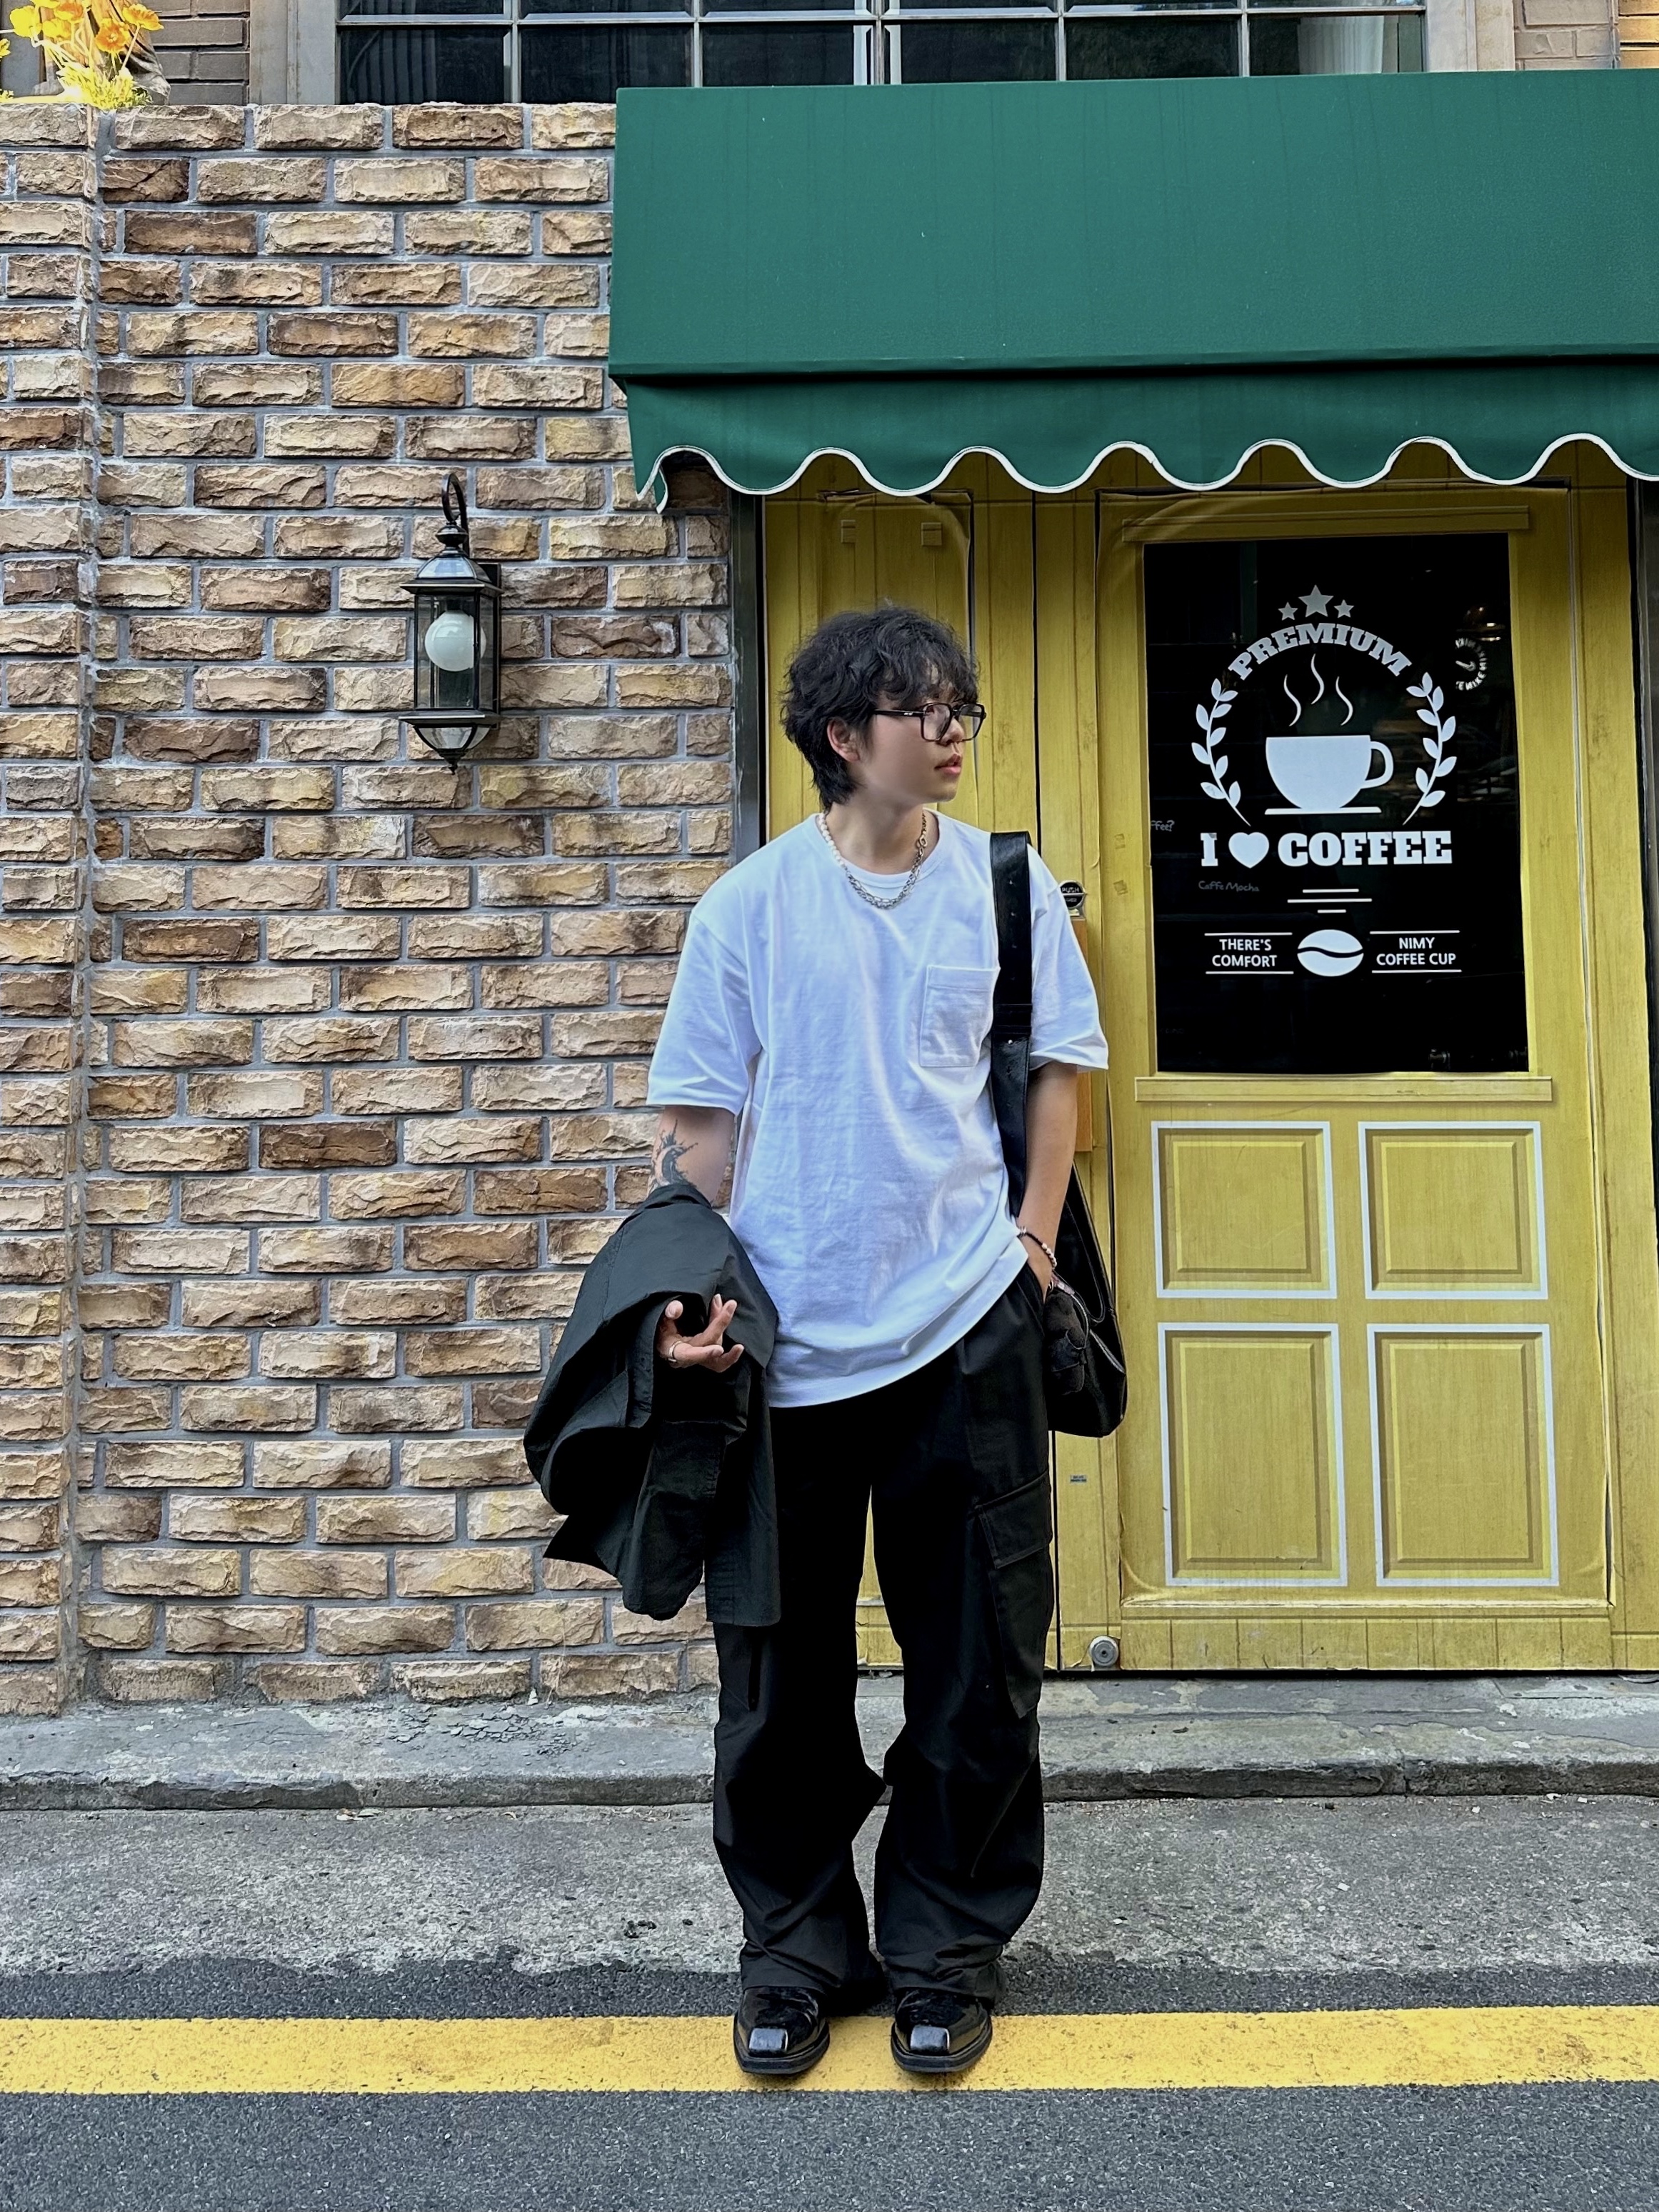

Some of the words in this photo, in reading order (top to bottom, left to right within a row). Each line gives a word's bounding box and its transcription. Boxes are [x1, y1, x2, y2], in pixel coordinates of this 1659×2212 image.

[1228, 622, 1413, 683] PREMIUM
[1200, 832, 1218, 867] I
[1278, 830, 1453, 867] COFFEE
[1226, 881, 1260, 893] Mocha
[1219, 938, 1272, 951] THERE'S
[1398, 936, 1435, 949] NIMY
[1212, 954, 1278, 968] COMFORT
[1376, 953, 1425, 966] COFFEE
[1429, 953, 1456, 965] CUP
